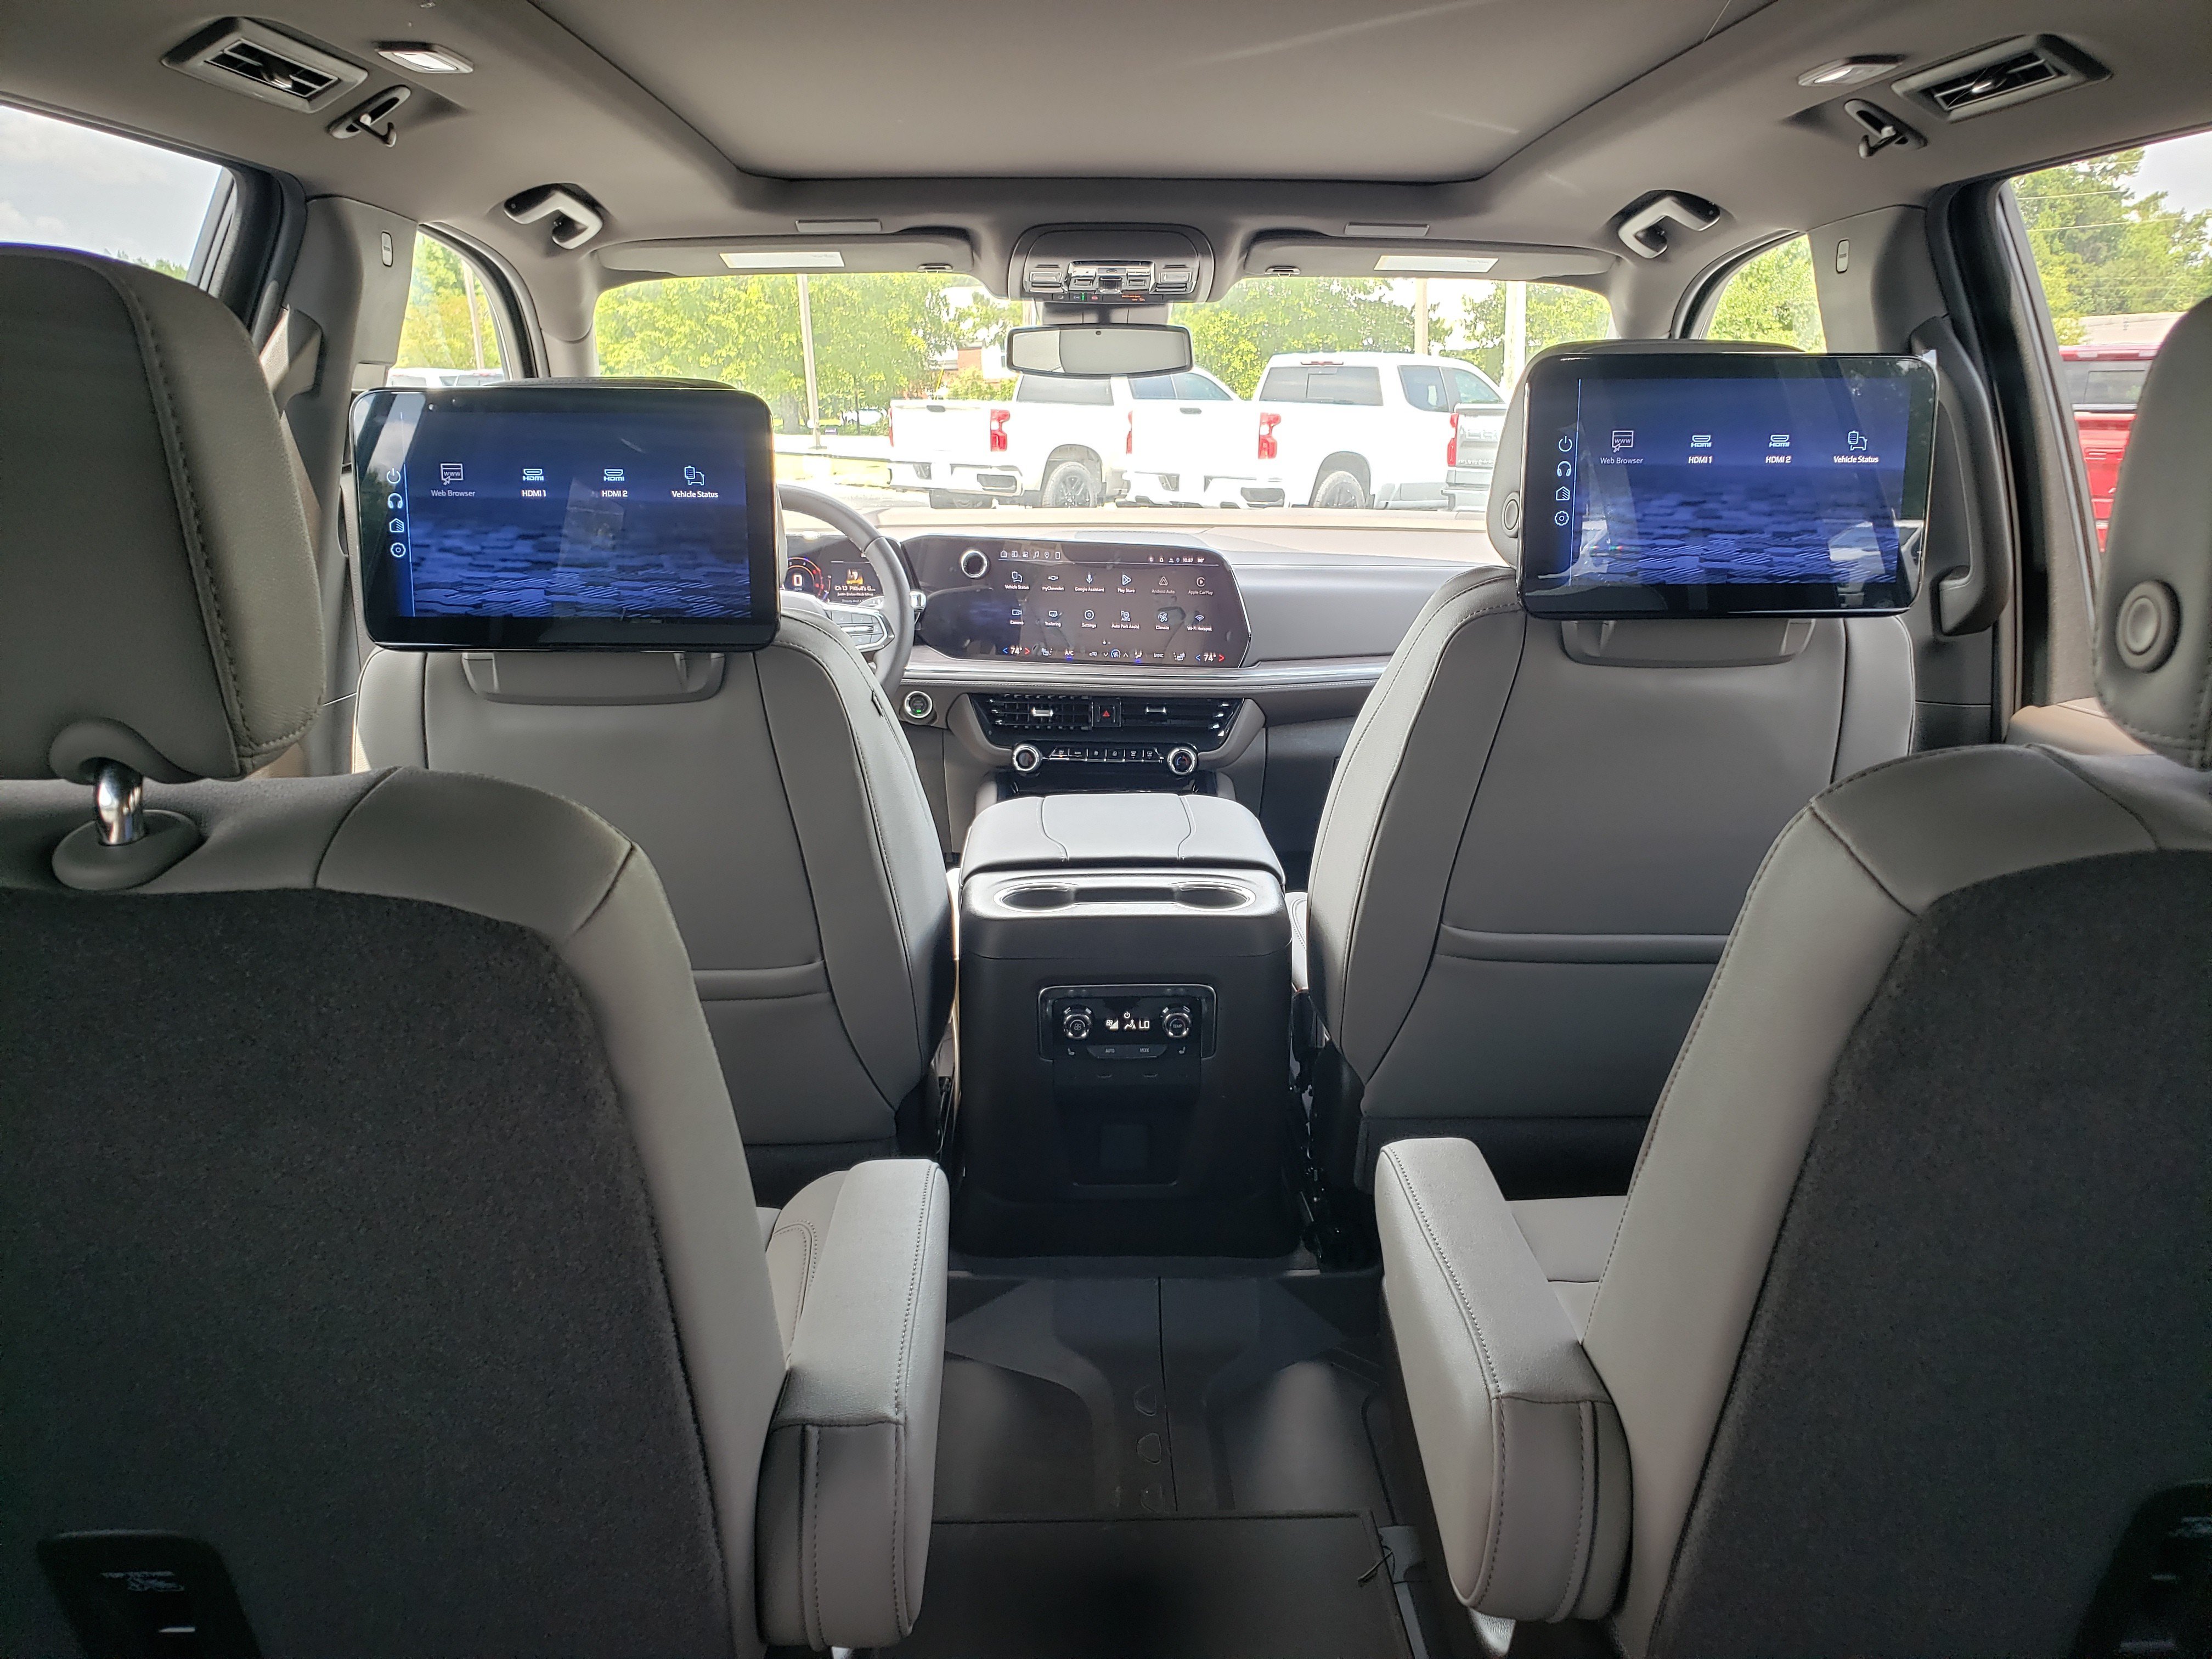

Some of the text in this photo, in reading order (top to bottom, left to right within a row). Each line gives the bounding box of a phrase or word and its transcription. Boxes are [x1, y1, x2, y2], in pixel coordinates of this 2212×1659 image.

[1833, 455, 1879, 464] Vehicle Status
[793, 574, 803, 586] 0
